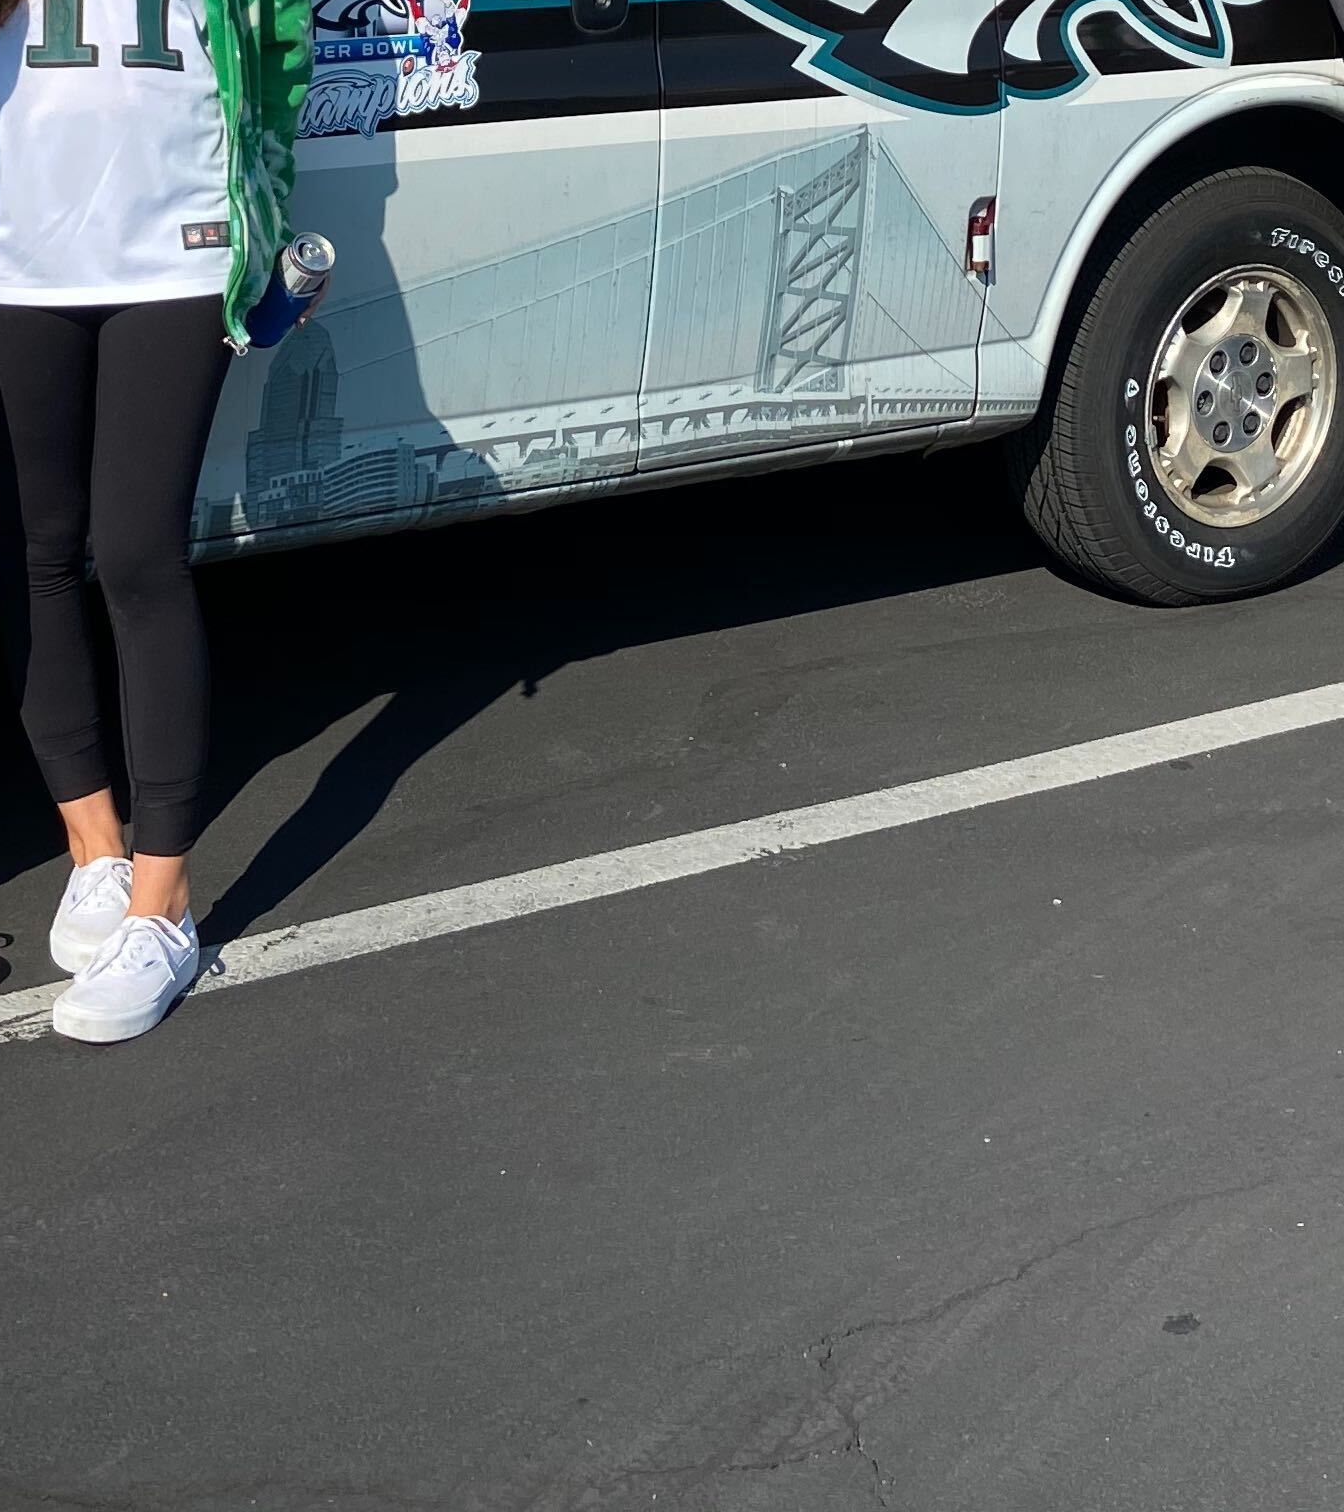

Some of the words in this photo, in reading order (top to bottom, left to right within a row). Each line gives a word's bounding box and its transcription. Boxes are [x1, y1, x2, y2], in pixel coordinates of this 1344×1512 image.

[314, 44, 351, 59] PER
[362, 41, 420, 56] BOWL
[1125, 424, 1236, 568] Firestone
